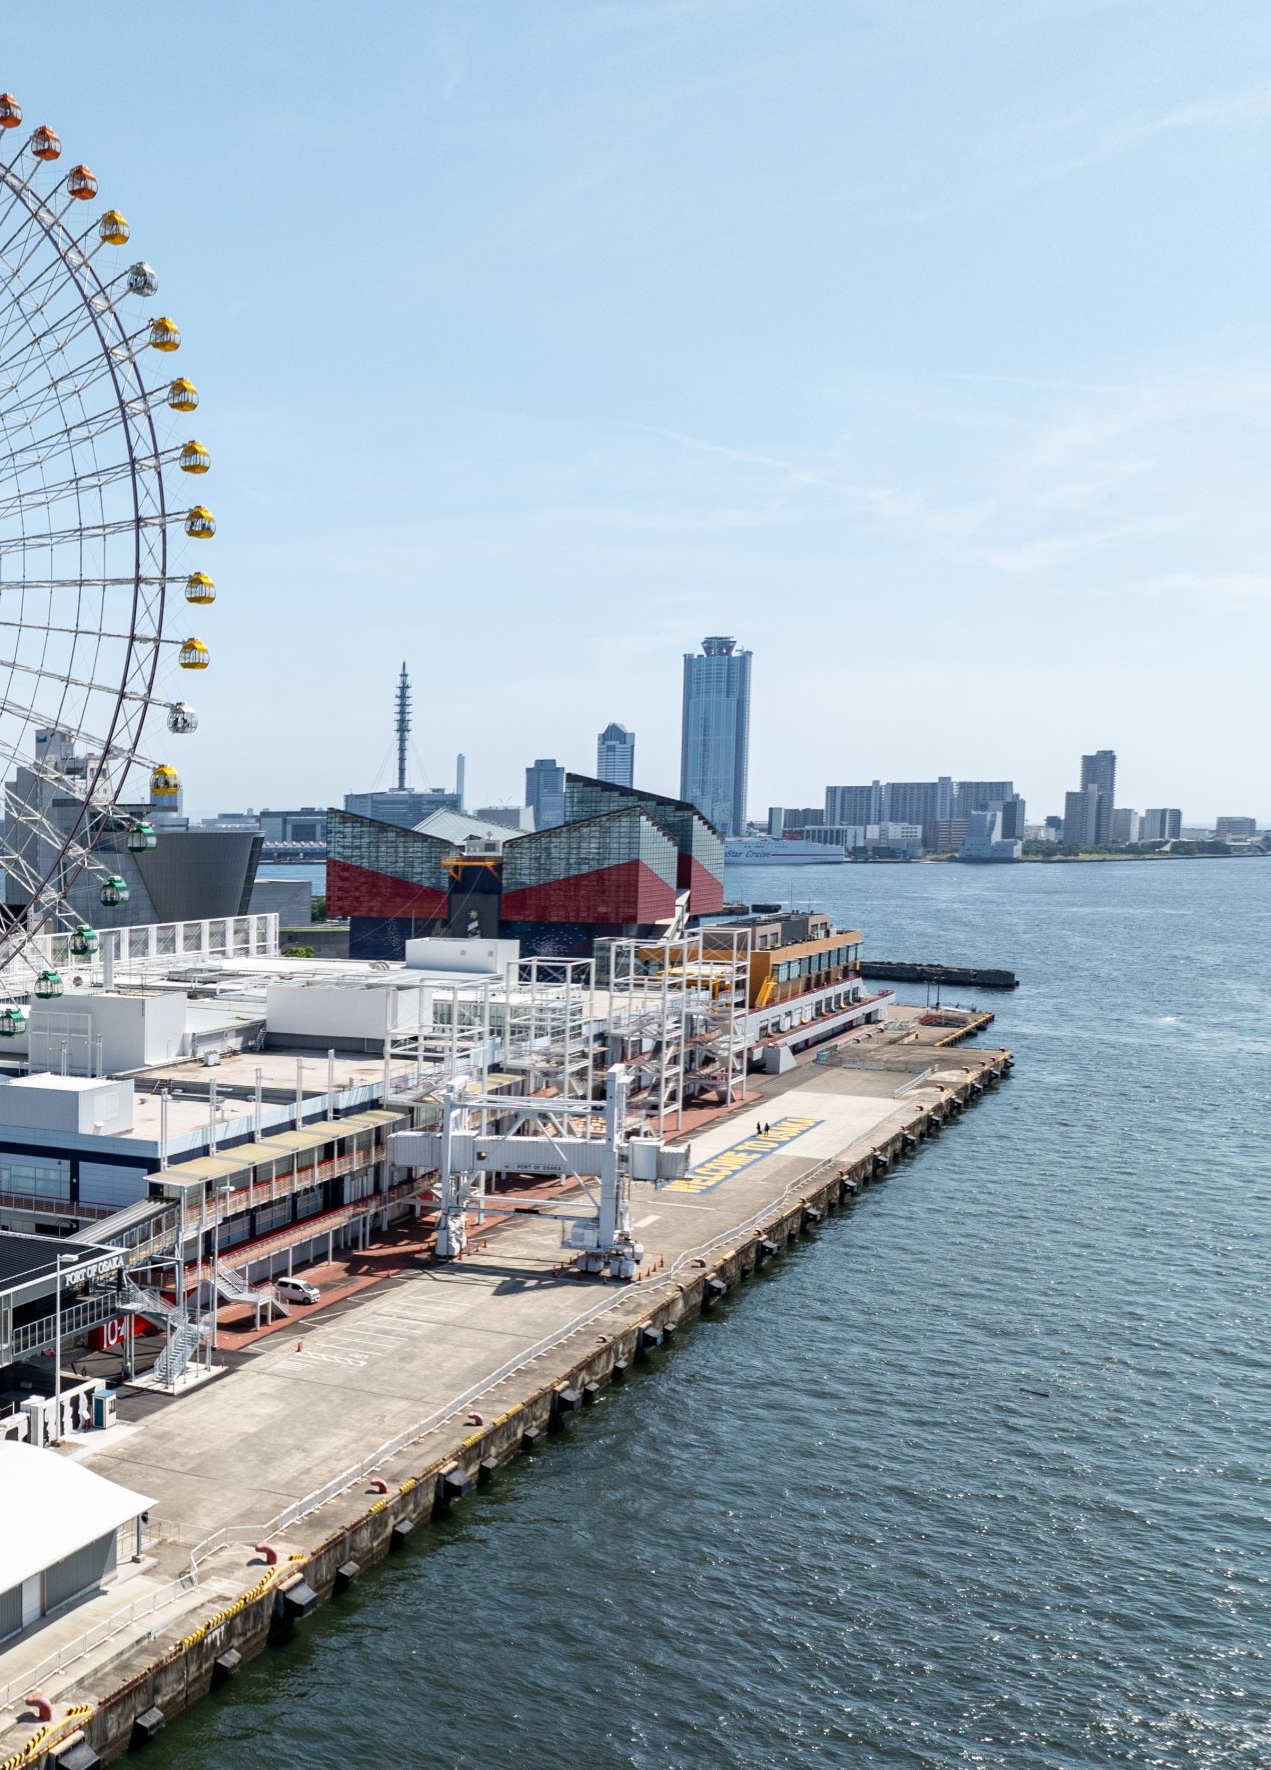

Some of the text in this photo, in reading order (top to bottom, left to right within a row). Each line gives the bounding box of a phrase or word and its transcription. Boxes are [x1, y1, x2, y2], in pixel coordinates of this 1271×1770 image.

[745, 849, 770, 858] Cruise
[660, 1117, 822, 1193] WELCOME TO OSAKA
[65, 1255, 125, 1287] PORT OF OSAKA
